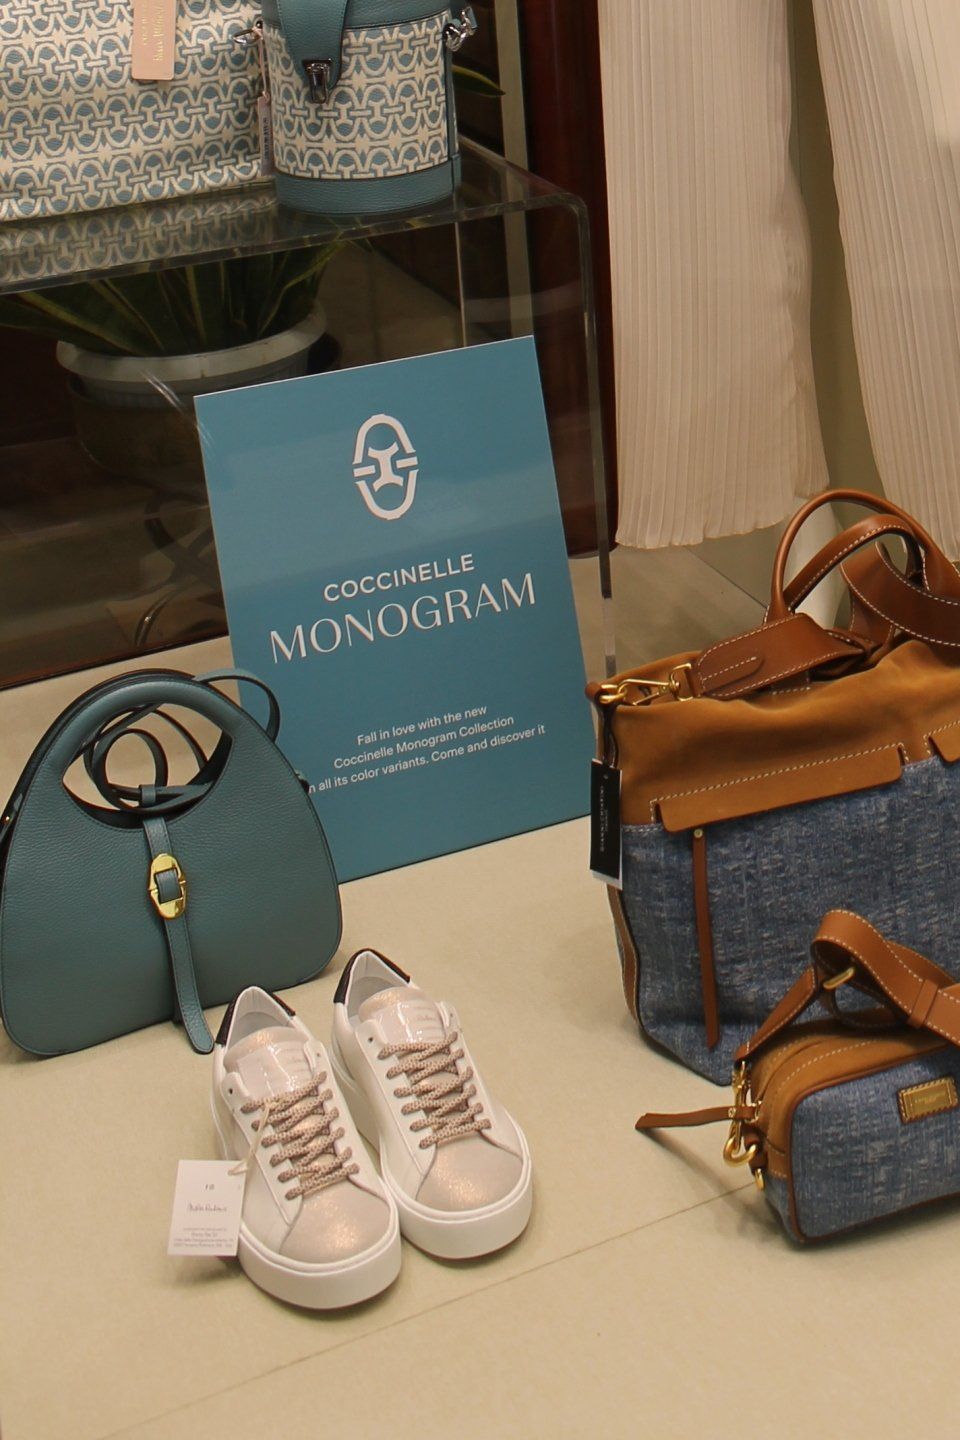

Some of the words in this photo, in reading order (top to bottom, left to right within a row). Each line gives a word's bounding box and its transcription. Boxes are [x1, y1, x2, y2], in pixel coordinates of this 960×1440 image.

[323, 553, 475, 602] COCCINELLE
[270, 573, 536, 664] MONOGRAM
[333, 746, 394, 769] Coccinelle
[396, 731, 457, 754] Monogram
[459, 716, 515, 737] Collection
[357, 731, 377, 746] Fall
[379, 729, 390, 740] in
[392, 724, 415, 737] love
[417, 716, 442, 731] with
[443, 713, 462, 724] the
[464, 706, 487, 719] new
[318, 778, 332, 791] all
[334, 776, 349, 787] its
[350, 768, 380, 783] color
[381, 755, 430, 775] variants.
[431, 746, 465, 762] Come
[467, 738, 488, 753] and
[490, 727, 536, 747] discover
[537, 724, 546, 735] it
